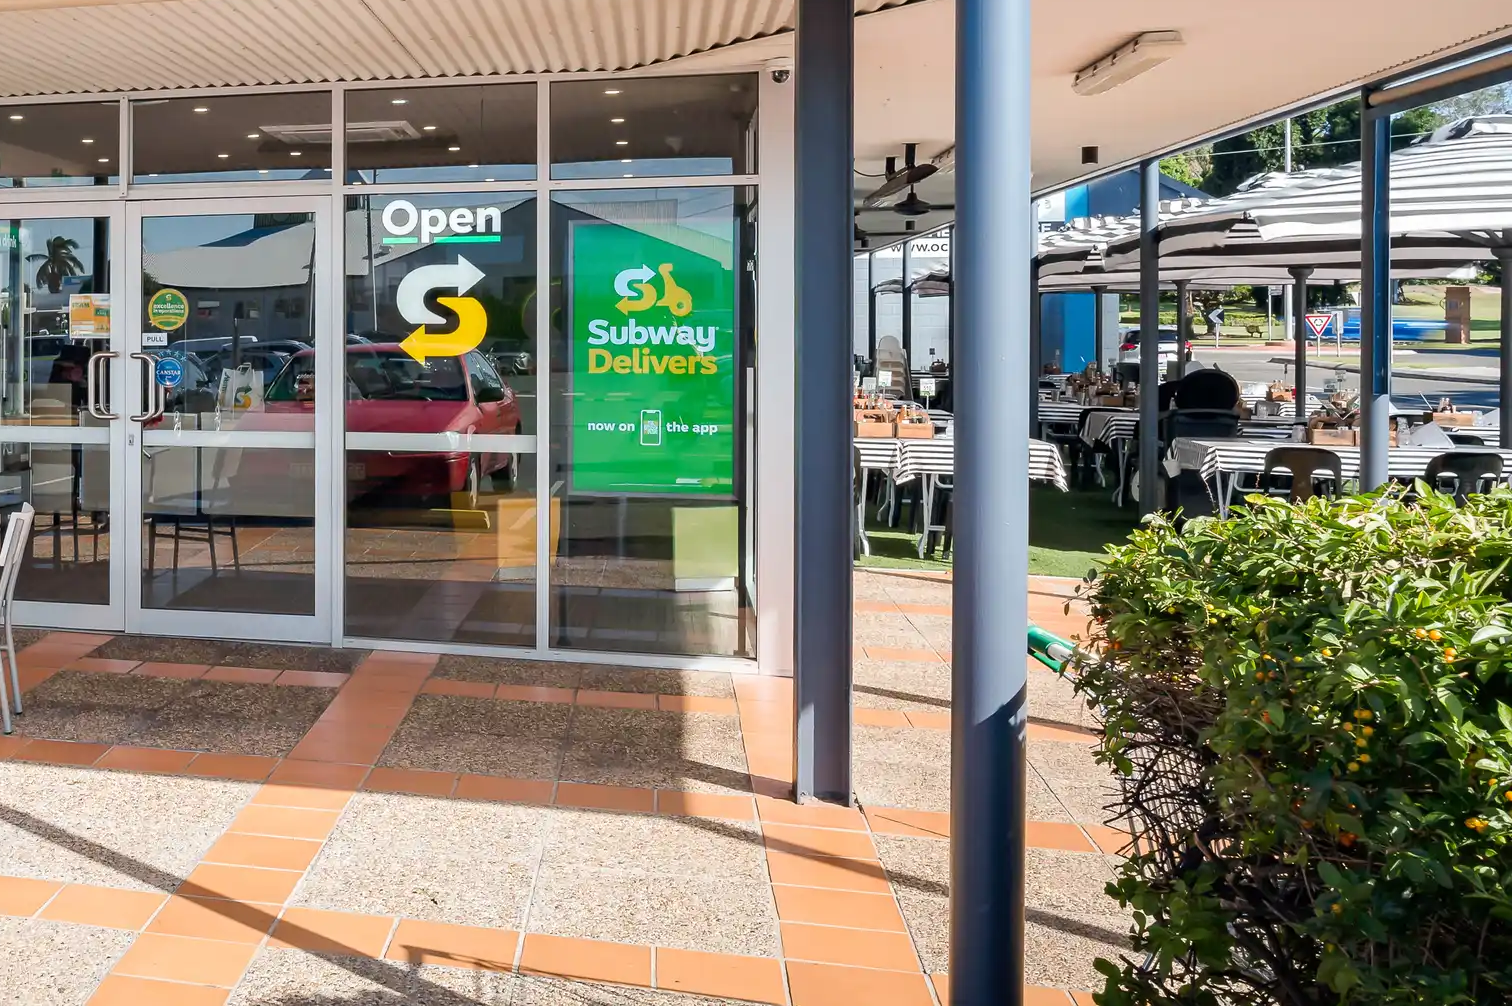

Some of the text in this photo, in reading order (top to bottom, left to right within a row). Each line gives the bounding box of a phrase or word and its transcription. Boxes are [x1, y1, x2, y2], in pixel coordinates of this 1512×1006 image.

[382, 199, 502, 244] Open
[588, 318, 716, 353] Subway
[588, 347, 718, 375] Delivers
[588, 421, 636, 432] now on
[666, 422, 719, 436] the app
